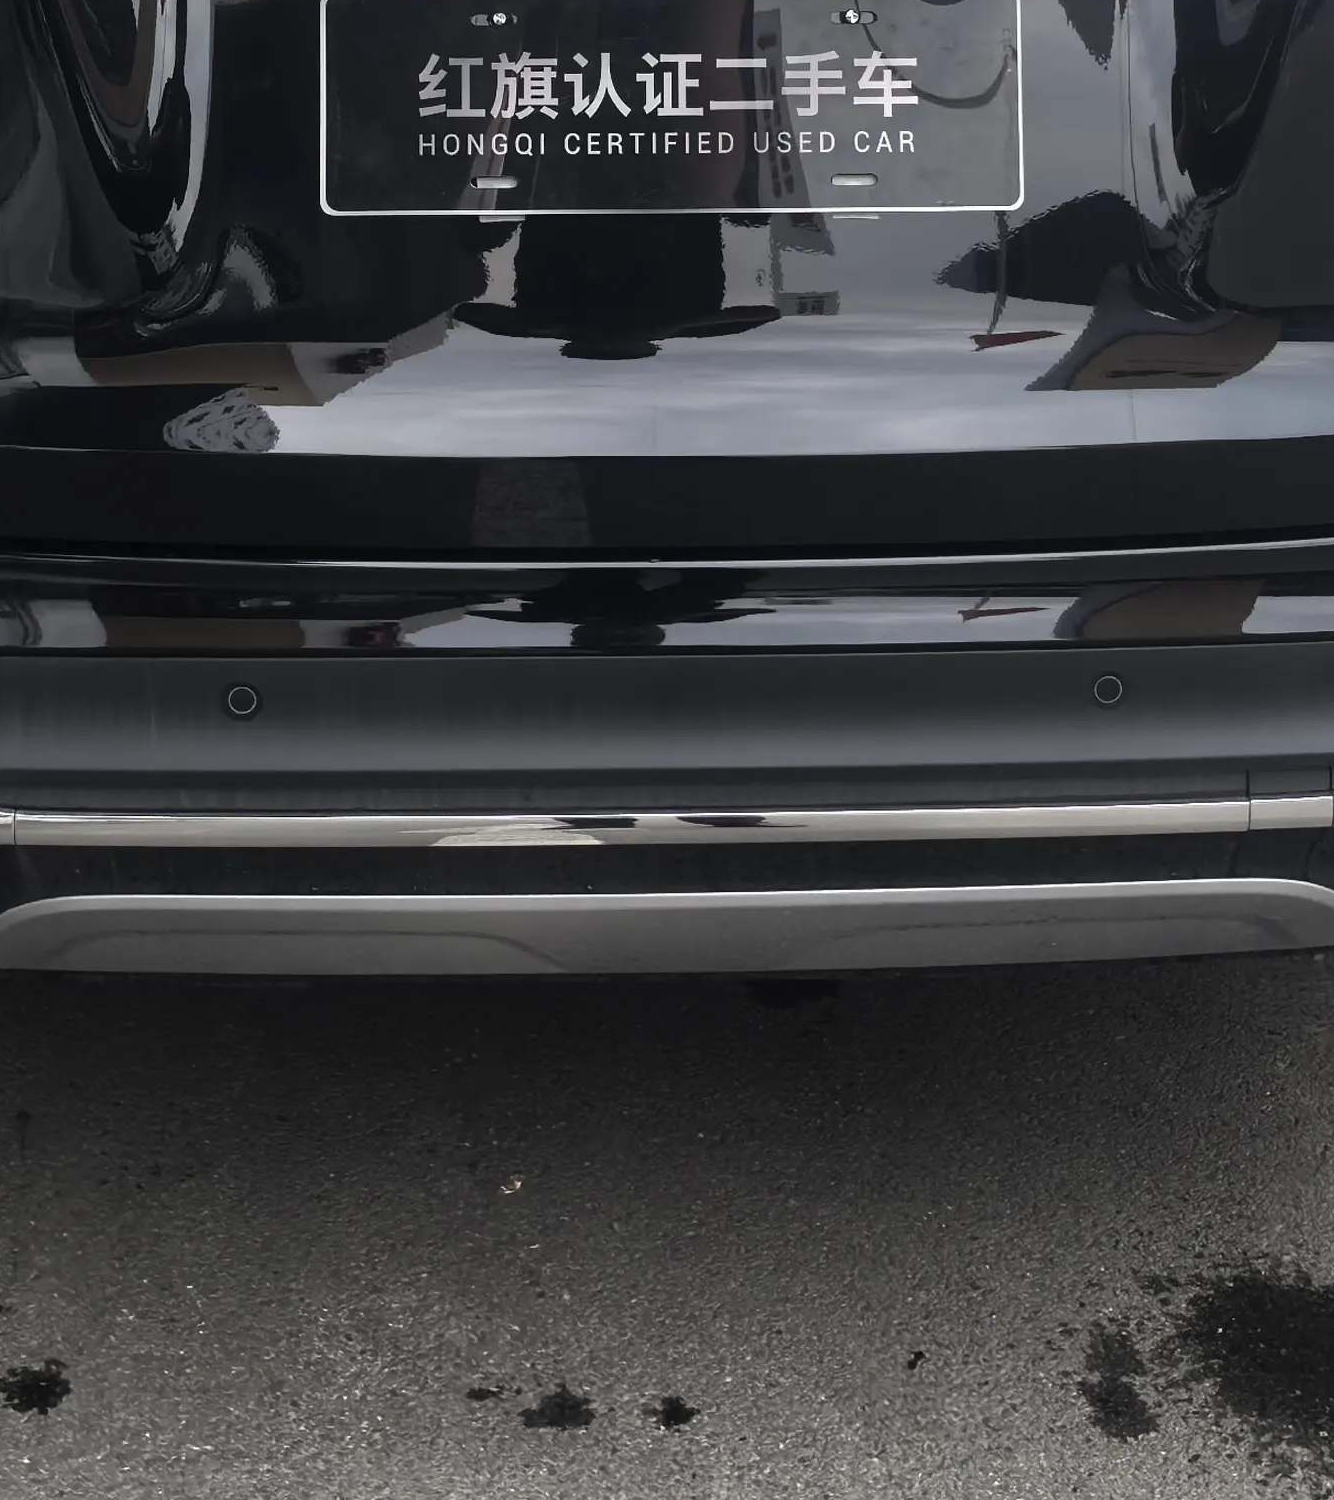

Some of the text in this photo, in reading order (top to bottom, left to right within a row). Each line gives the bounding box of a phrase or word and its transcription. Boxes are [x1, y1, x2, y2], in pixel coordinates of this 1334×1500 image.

[418, 50, 919, 120] 红旗认证二手车
[418, 130, 916, 156] HONGQI CERTIFIED USED CAR
